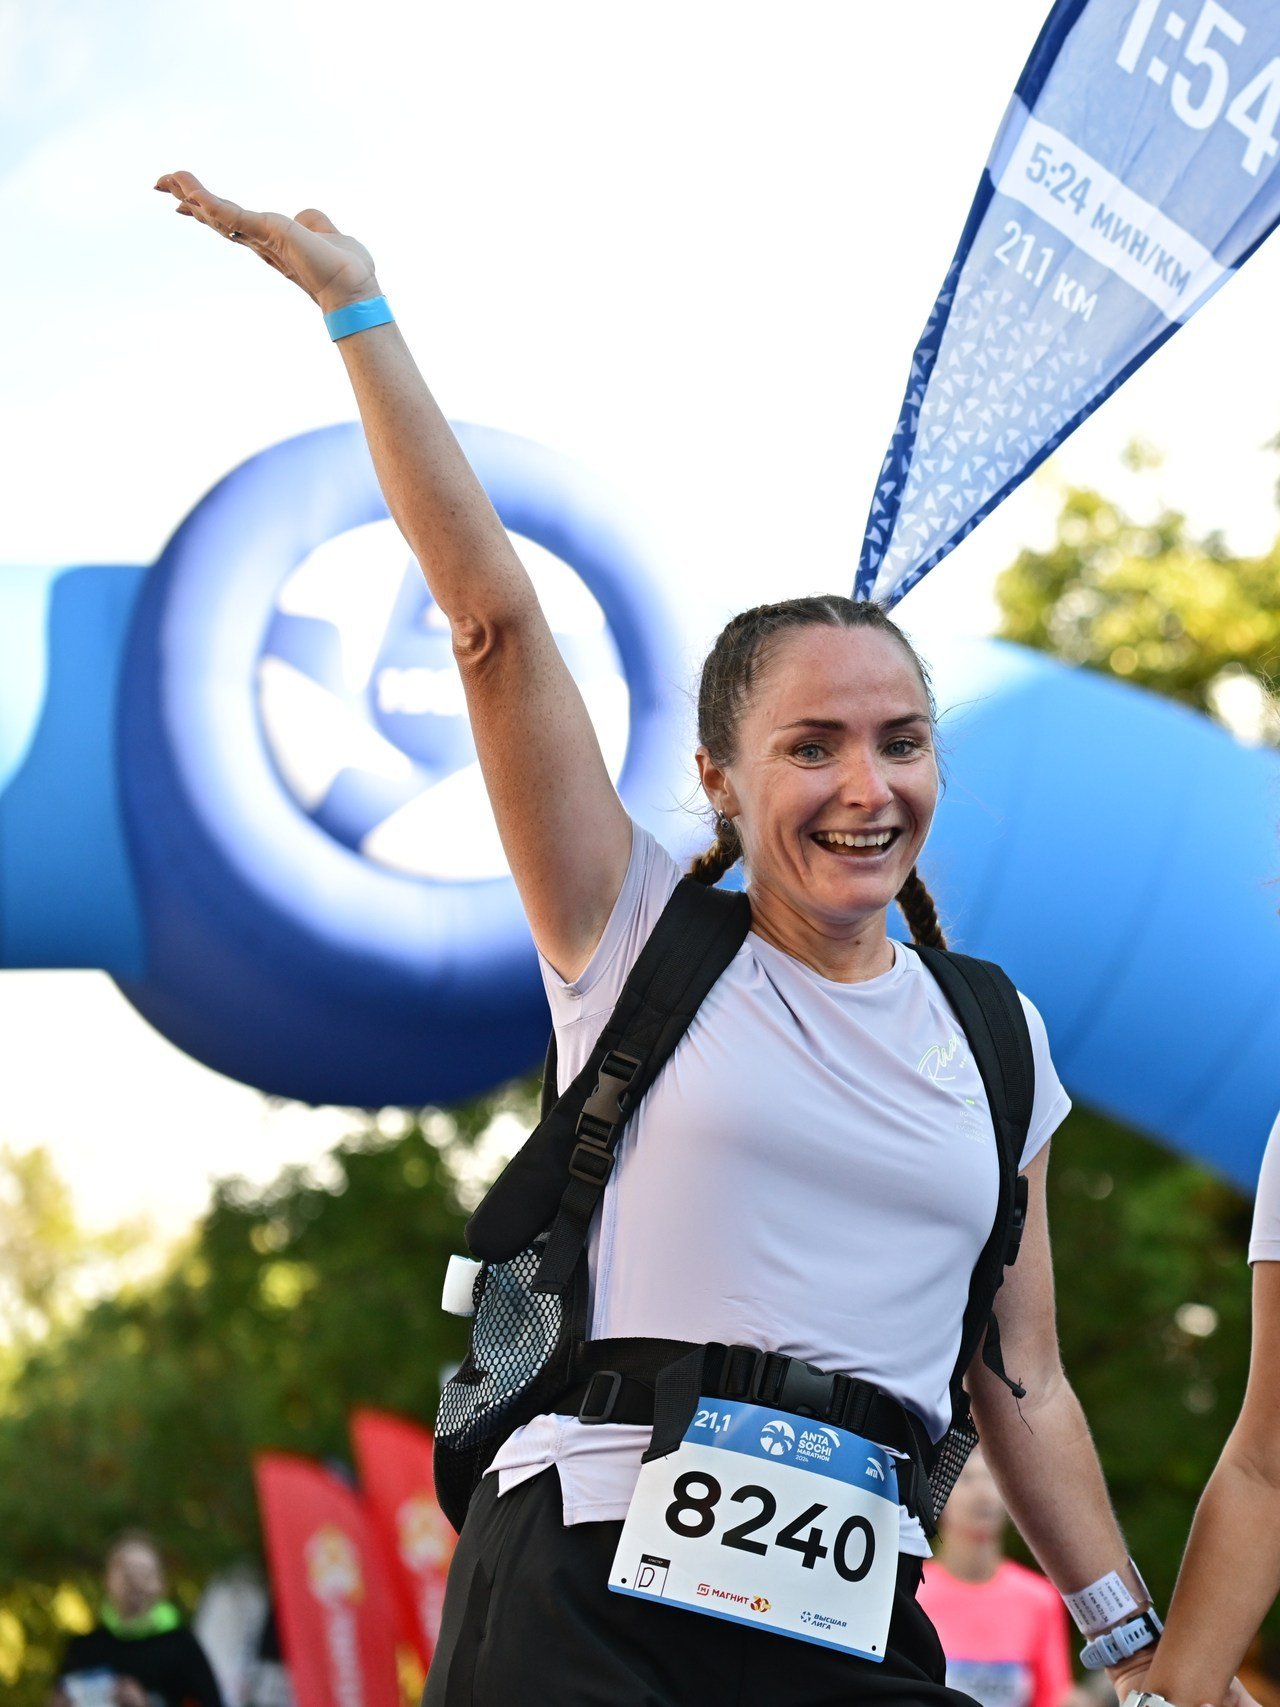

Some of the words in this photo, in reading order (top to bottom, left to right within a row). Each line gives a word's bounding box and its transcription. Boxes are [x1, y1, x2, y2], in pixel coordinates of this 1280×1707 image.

[1026, 141, 1092, 215] 5:24
[994, 220, 1055, 287] 21.1
[694, 1410, 732, 1433] 21,1
[800, 1431, 829, 1447] ANTA
[796, 1448, 830, 1463] MARATHON
[798, 1440, 832, 1457] SOCHI
[865, 1466, 878, 1479] ANTA
[665, 1471, 875, 1583] 8240
[712, 1589, 749, 1605] МАГНИТ
[811, 1620, 831, 1630] ЛИГА
[813, 1614, 848, 1628] ВЫСШАЯ
